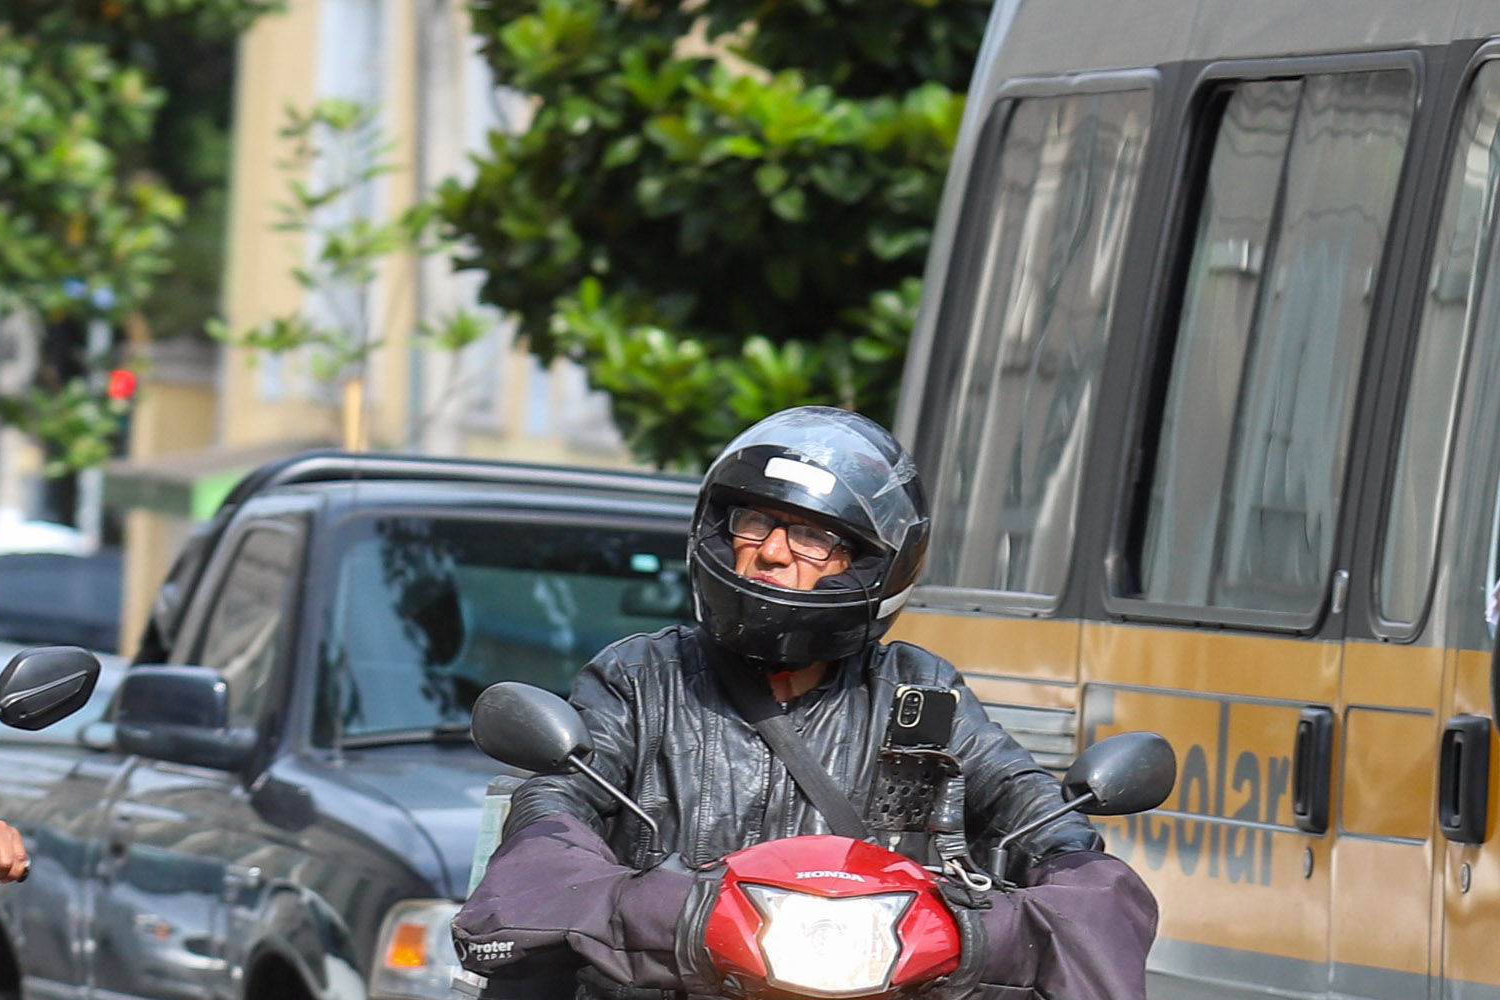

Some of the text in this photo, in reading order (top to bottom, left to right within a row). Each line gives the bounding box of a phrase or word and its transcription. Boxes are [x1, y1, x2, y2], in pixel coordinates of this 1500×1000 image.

[796, 870, 866, 882] HONDA
[468, 941, 515, 954] Proter
[476, 952, 513, 961] CAPAS
